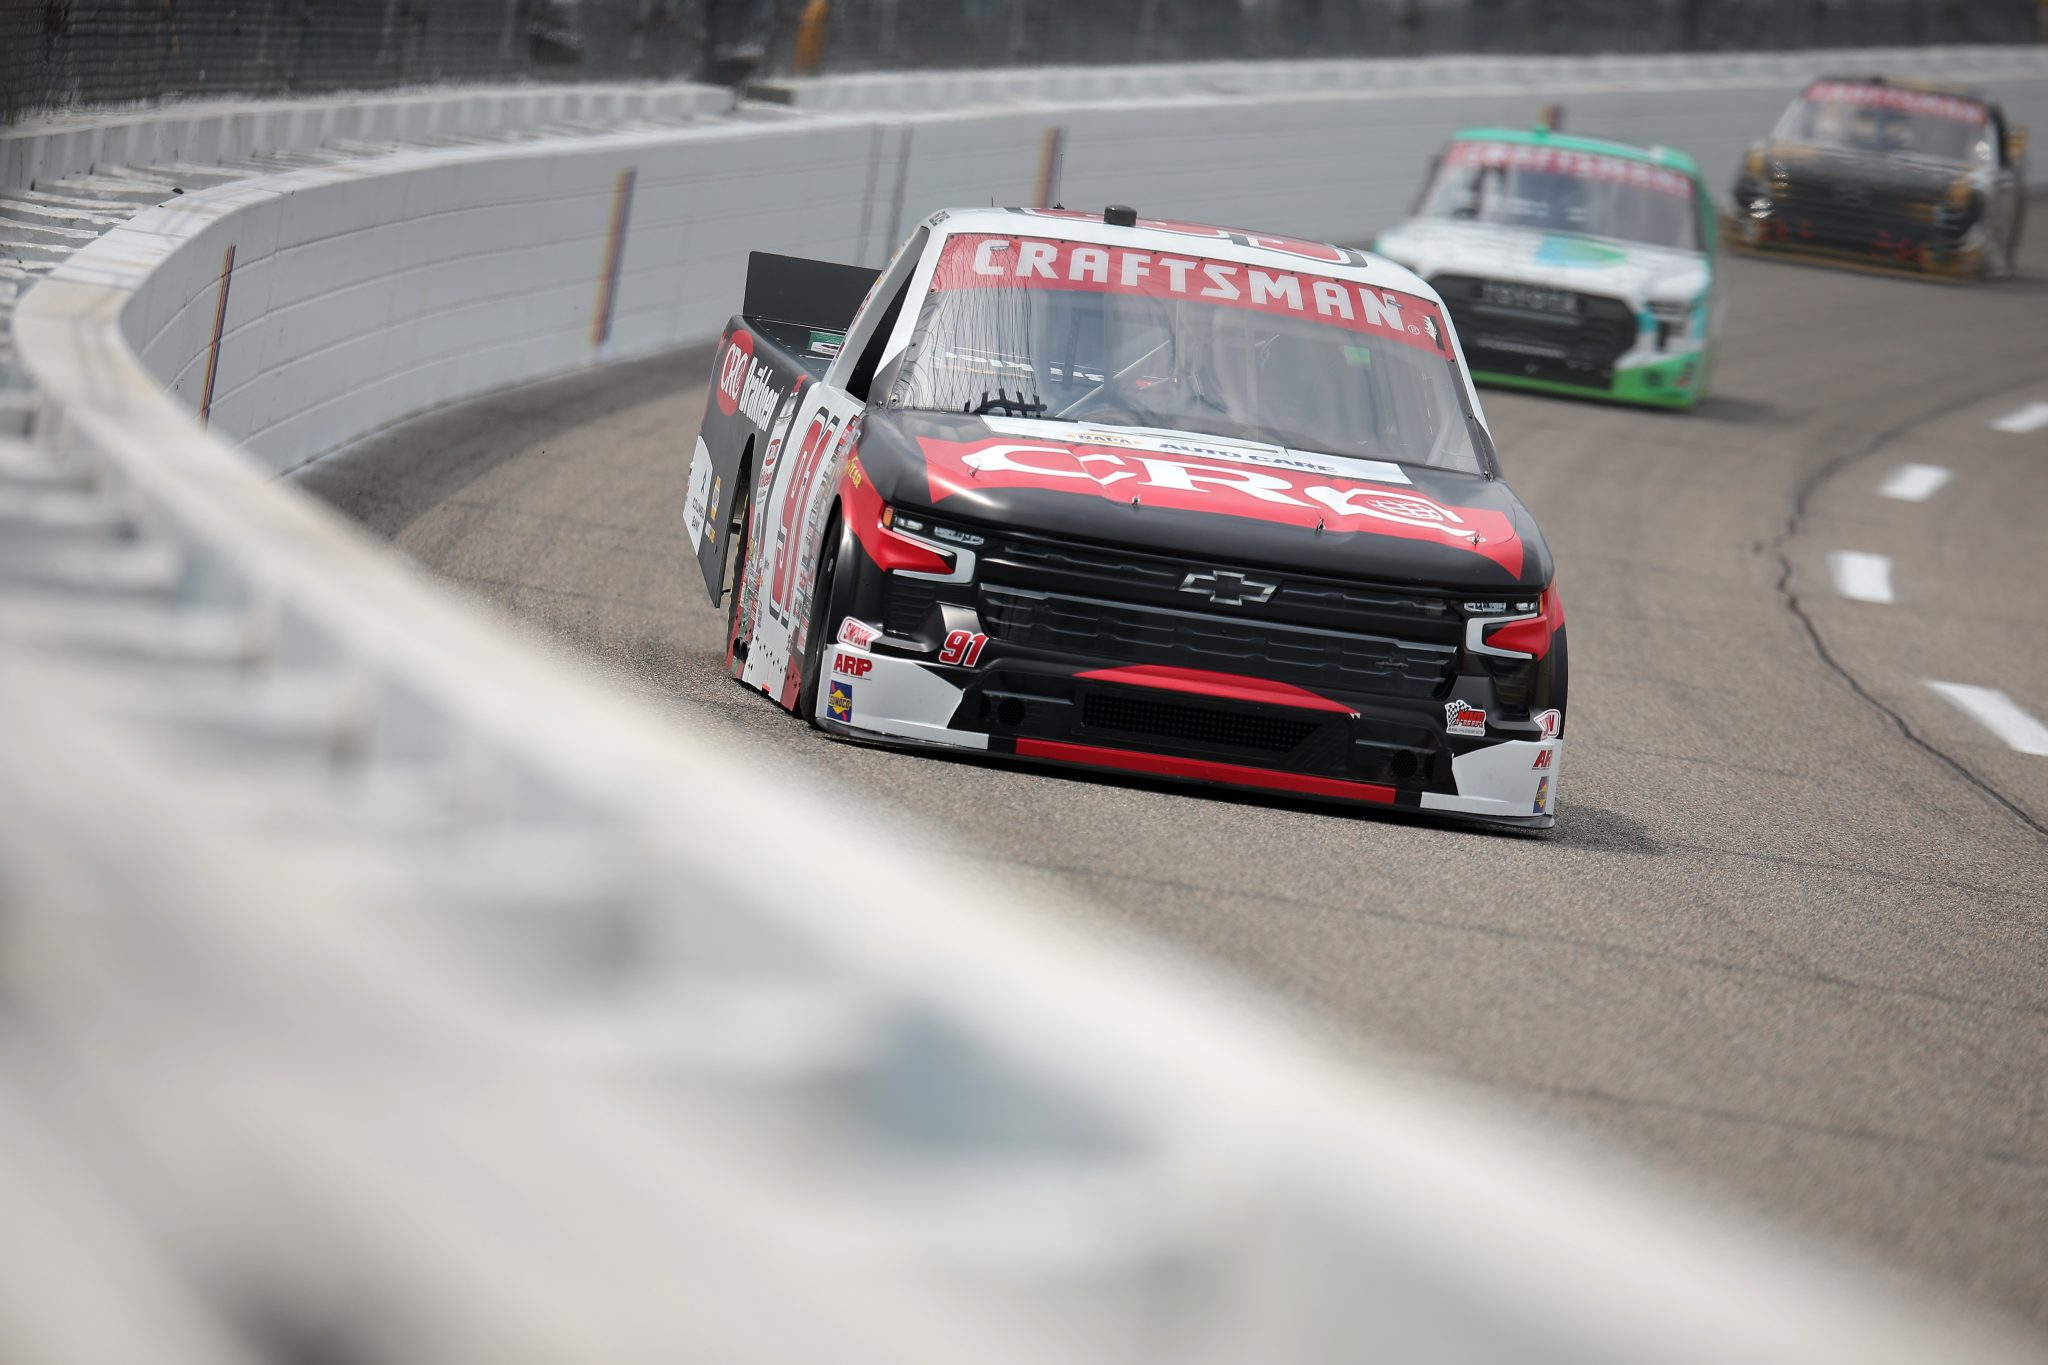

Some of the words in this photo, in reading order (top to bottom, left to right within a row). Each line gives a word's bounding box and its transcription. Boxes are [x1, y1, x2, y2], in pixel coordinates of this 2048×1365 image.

[974, 240, 1404, 332] CRAFTSMAN
[721, 343, 748, 400] CRC
[1078, 433, 1132, 445] NAPA
[1159, 442, 1242, 459] AUTO
[1248, 454, 1338, 474] CARE
[961, 445, 1476, 537] CRC
[833, 653, 873, 677] ARP
[939, 630, 989, 668] 91
[828, 695, 851, 711] SUNOCO
